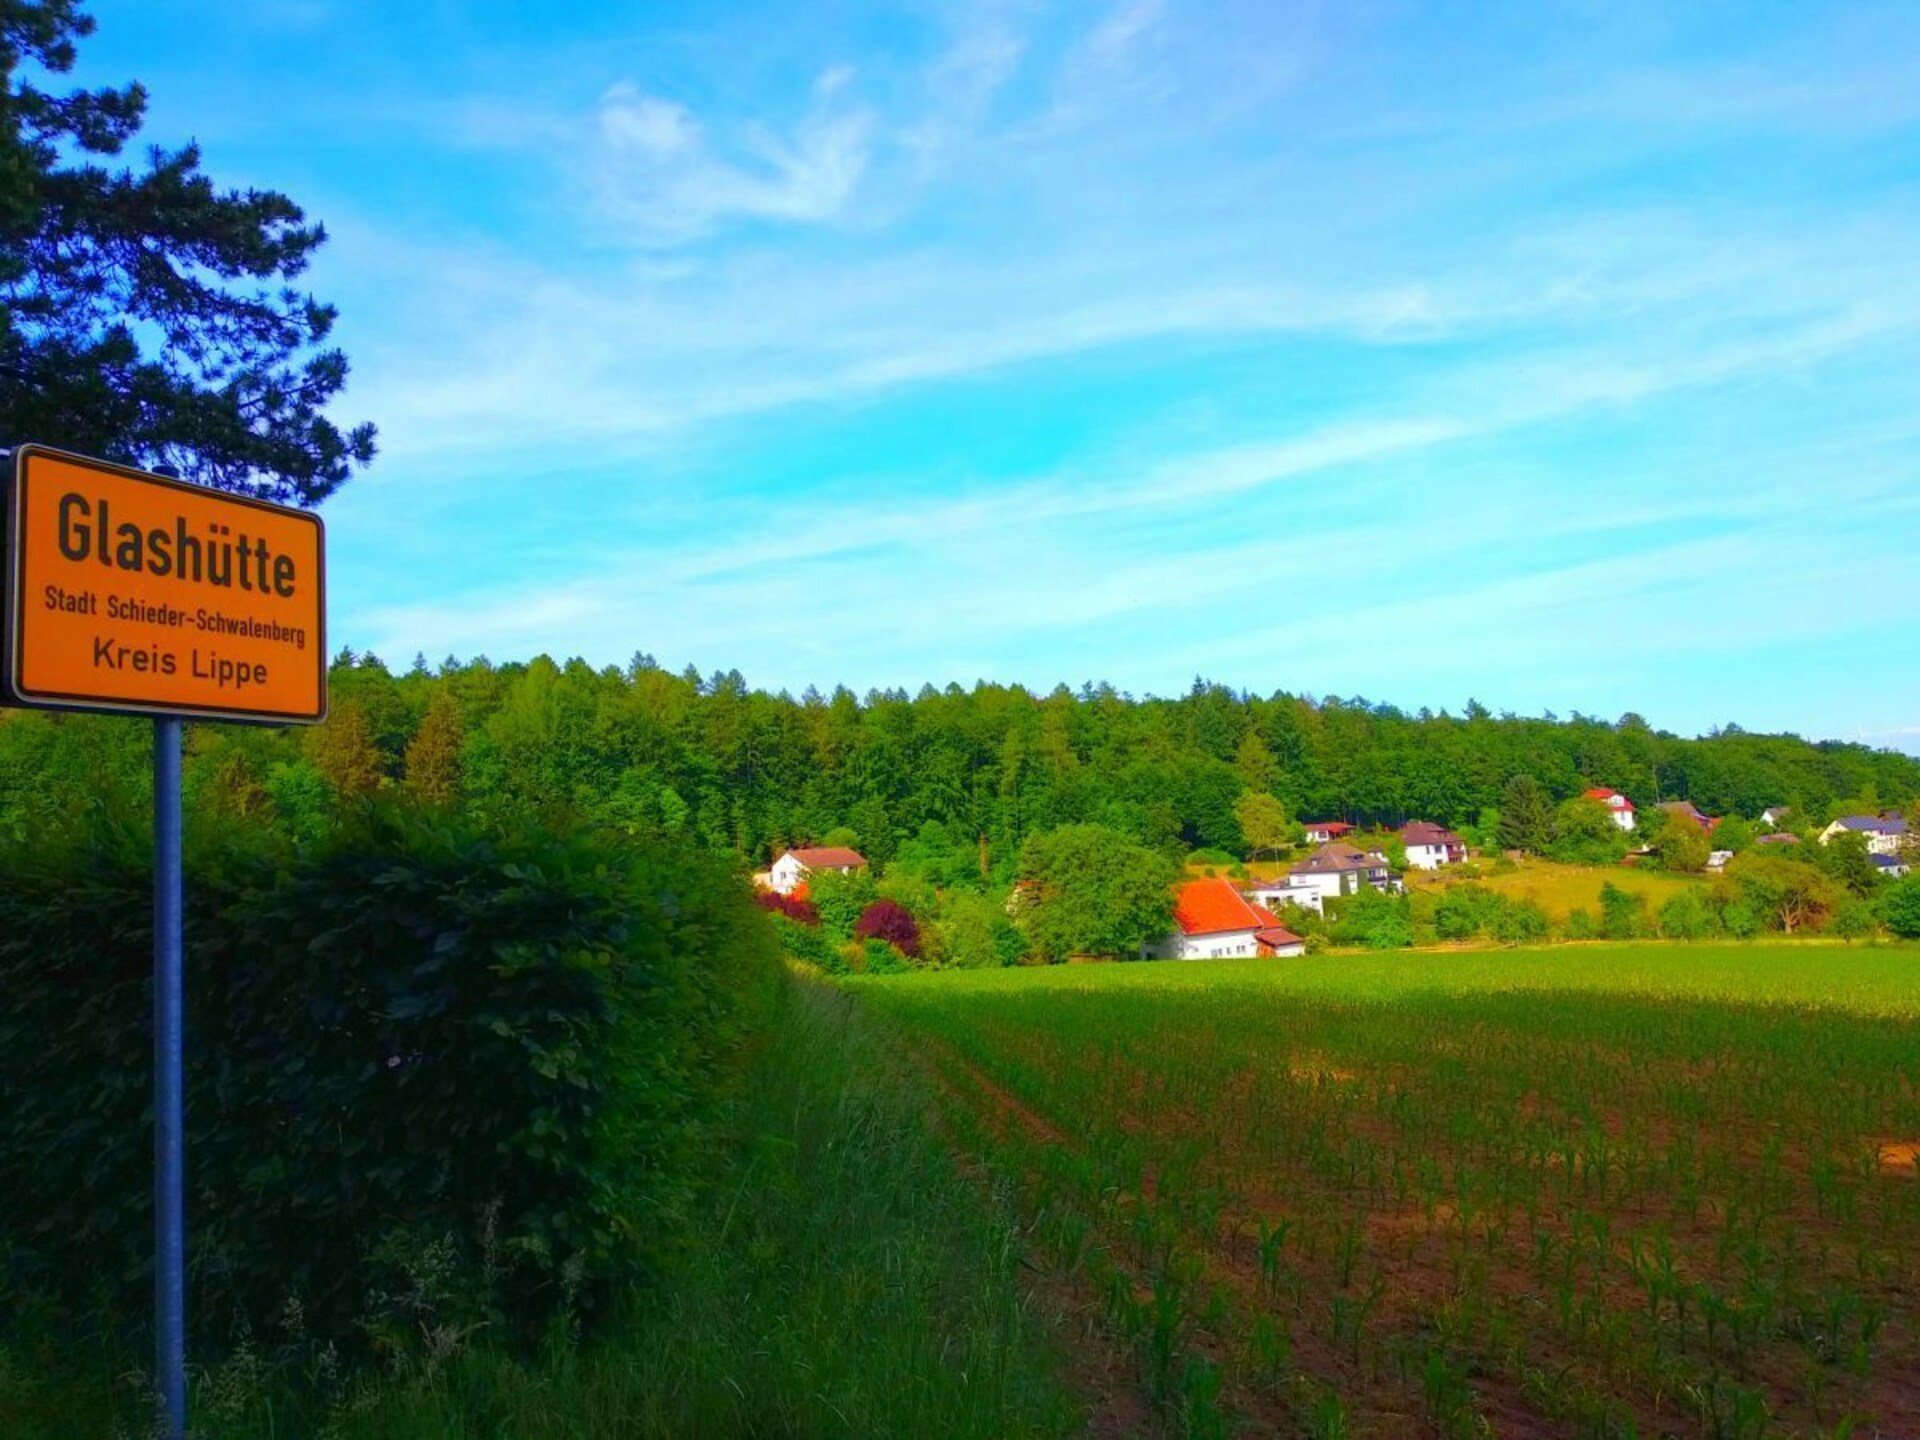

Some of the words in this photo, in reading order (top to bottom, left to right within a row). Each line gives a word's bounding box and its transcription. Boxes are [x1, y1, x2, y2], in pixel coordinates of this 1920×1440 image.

[58, 492, 296, 598] Glashütte
[45, 586, 97, 615] Stadt
[108, 595, 305, 648] Schieder-Schwalenberg
[94, 637, 177, 674] Kreis
[192, 650, 267, 688] Lippe
